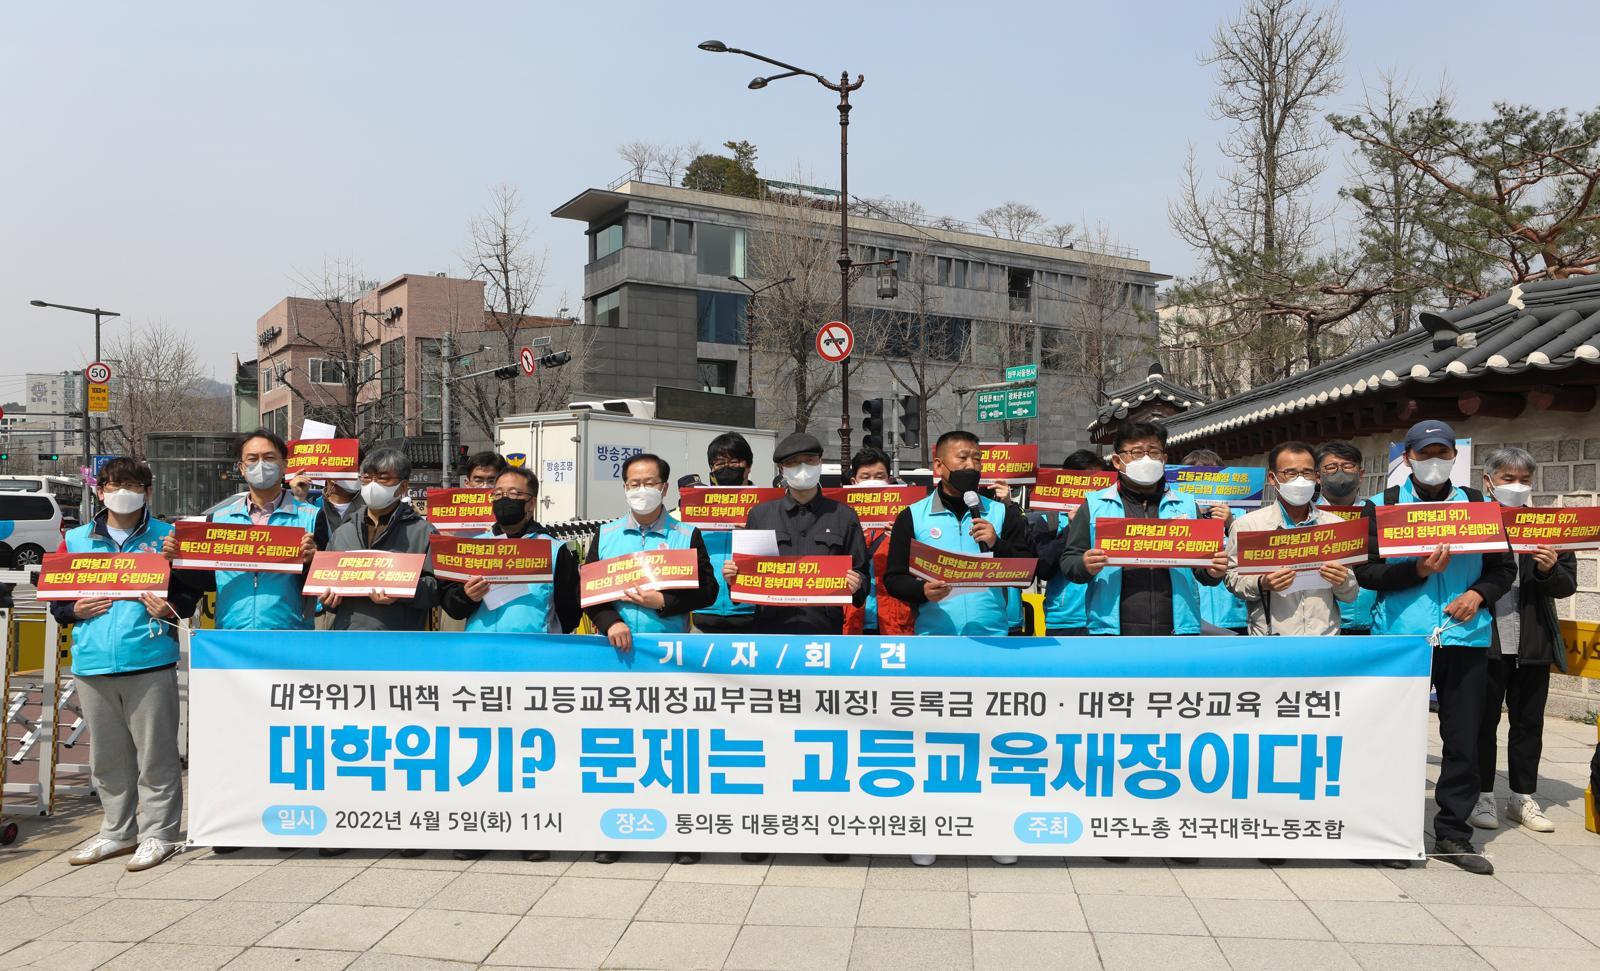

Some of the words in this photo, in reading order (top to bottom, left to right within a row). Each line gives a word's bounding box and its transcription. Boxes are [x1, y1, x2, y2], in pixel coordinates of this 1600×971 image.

[91, 367, 106, 379] 50
[546, 461, 573, 471] 방송조명
[554, 472, 563, 482] 21
[407, 488, 428, 498] Cafe
[451, 493, 486, 504] 대학붕괴
[704, 493, 739, 504] 대학붕괴
[739, 493, 759, 504] 위기,
[847, 492, 881, 504] 대학붕괴
[882, 492, 902, 503] 위기,
[431, 506, 457, 517] 특단의
[458, 505, 493, 517] 정부대책
[685, 505, 710, 517] 특단의
[711, 506, 745, 517] 정부대책
[1407, 509, 1447, 523] 대학붕괴
[1448, 509, 1471, 521] 위기,
[1515, 512, 1557, 525] 대학붕괴
[1557, 513, 1578, 524] 위기,
[206, 528, 248, 541] 대학붕괴
[249, 530, 272, 542] 위기,
[1125, 524, 1167, 537] 대학붕괴
[1168, 525, 1191, 537] 위기,
[1383, 526, 1415, 540] 특단의
[1416, 524, 1457, 538] 정부대책
[1458, 523, 1500, 536] 수립하라!
[1522, 527, 1562, 538] 정부대책
[1269, 531, 1311, 547] 대학붕괴
[1313, 529, 1337, 543] 위기,
[180, 541, 211, 554] 특단의
[213, 543, 255, 556] 정부대책
[256, 545, 300, 558] 수립하라!
[456, 543, 495, 556] 대학붕괴
[497, 544, 520, 556] 위기,
[1100, 538, 1132, 551] 특단의
[1133, 539, 1174, 552] 정부대책
[1175, 540, 1220, 553] 수립하라!
[1243, 549, 1275, 561] 특단의
[1277, 545, 1319, 560] 정부대책
[1321, 537, 1364, 555] 수립하라!
[70, 558, 113, 570] 대학붕괴
[113, 558, 137, 570] 위기,
[436, 554, 463, 566] 특단의
[464, 556, 503, 569] 정부대책
[505, 557, 548, 569] 수립하라!
[757, 561, 797, 575] 대학붕괴
[798, 562, 820, 574] 위기,
[44, 572, 75, 584] 특단의
[76, 572, 119, 584] 정부대책
[120, 572, 165, 584] 수립하라!
[735, 575, 762, 586] 특단의
[764, 577, 804, 589] 정부대책
[805, 577, 850, 589] 수립하라!
[270, 683, 376, 711] 대학위기
[388, 684, 439, 712] 대책
[452, 685, 512, 713] 수립!
[524, 686, 802, 714] 고등교육재정교부금법
[814, 689, 878, 717] 제정!
[890, 690, 974, 718] 등록금
[985, 691, 1047, 717] ZERO
[1078, 691, 1135, 719] 대학
[1147, 691, 1262, 719] 무상교육
[1275, 690, 1341, 719] 실현!
[269, 725, 556, 793] 대학위기?
[579, 727, 766, 795] 문제는
[792, 729, 1343, 801] 고등교육재정이다!
[278, 809, 314, 831] 일시
[335, 810, 402, 831] 2022년
[409, 810, 440, 831] 4월
[448, 811, 512, 833] 5일(화)
[520, 812, 562, 833] 11시
[616, 812, 656, 834] 장소
[675, 813, 734, 835] 통의동
[742, 814, 819, 836] 대통령직
[827, 815, 926, 837] 인수위원회
[934, 815, 974, 837] 인근
[1028, 816, 1068, 838] 주최
[1091, 817, 1171, 839] 민주노총
[1178, 817, 1345, 840] 전국대학노동조합
